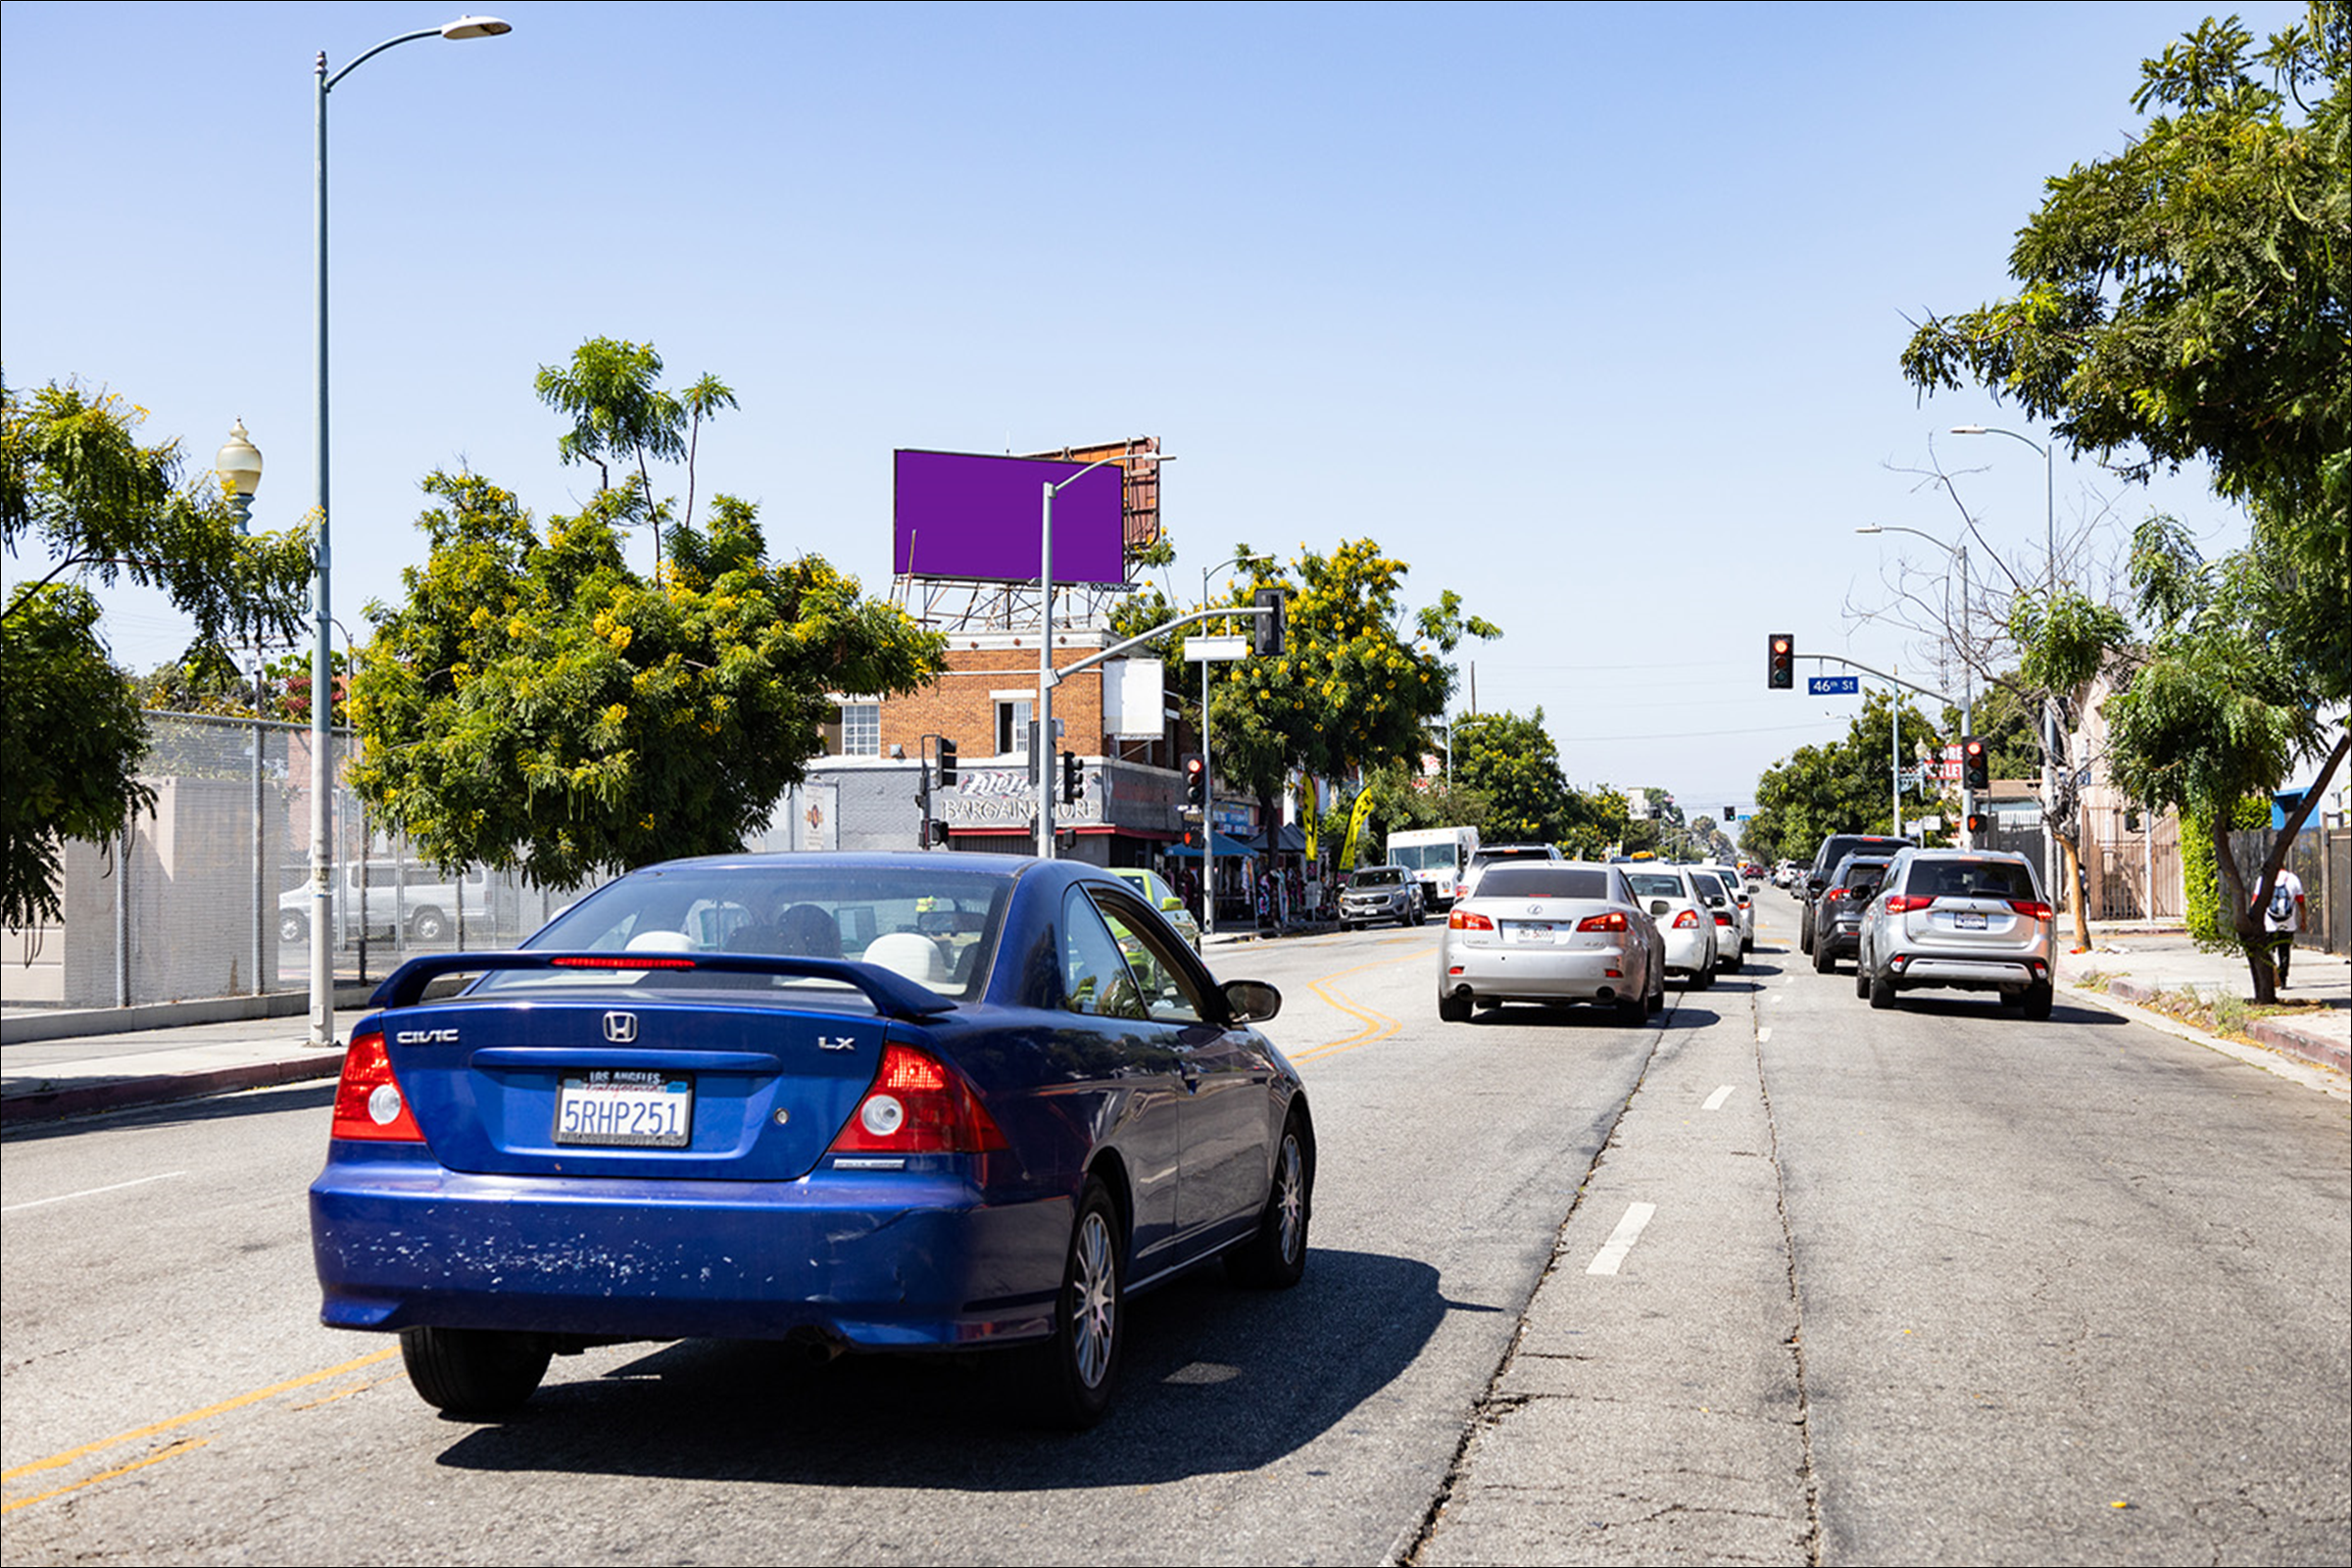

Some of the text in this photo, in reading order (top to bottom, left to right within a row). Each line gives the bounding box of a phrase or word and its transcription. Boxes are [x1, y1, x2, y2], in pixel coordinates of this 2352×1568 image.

[1813, 680, 1854, 692] 46th St
[942, 799, 1101, 820] BARGAIN SORE
[396, 1028, 459, 1044] CIVIC
[818, 1037, 856, 1050] LX
[589, 1070, 662, 1085] LOS ANGELES
[564, 1100, 678, 1135] 5RHP251
